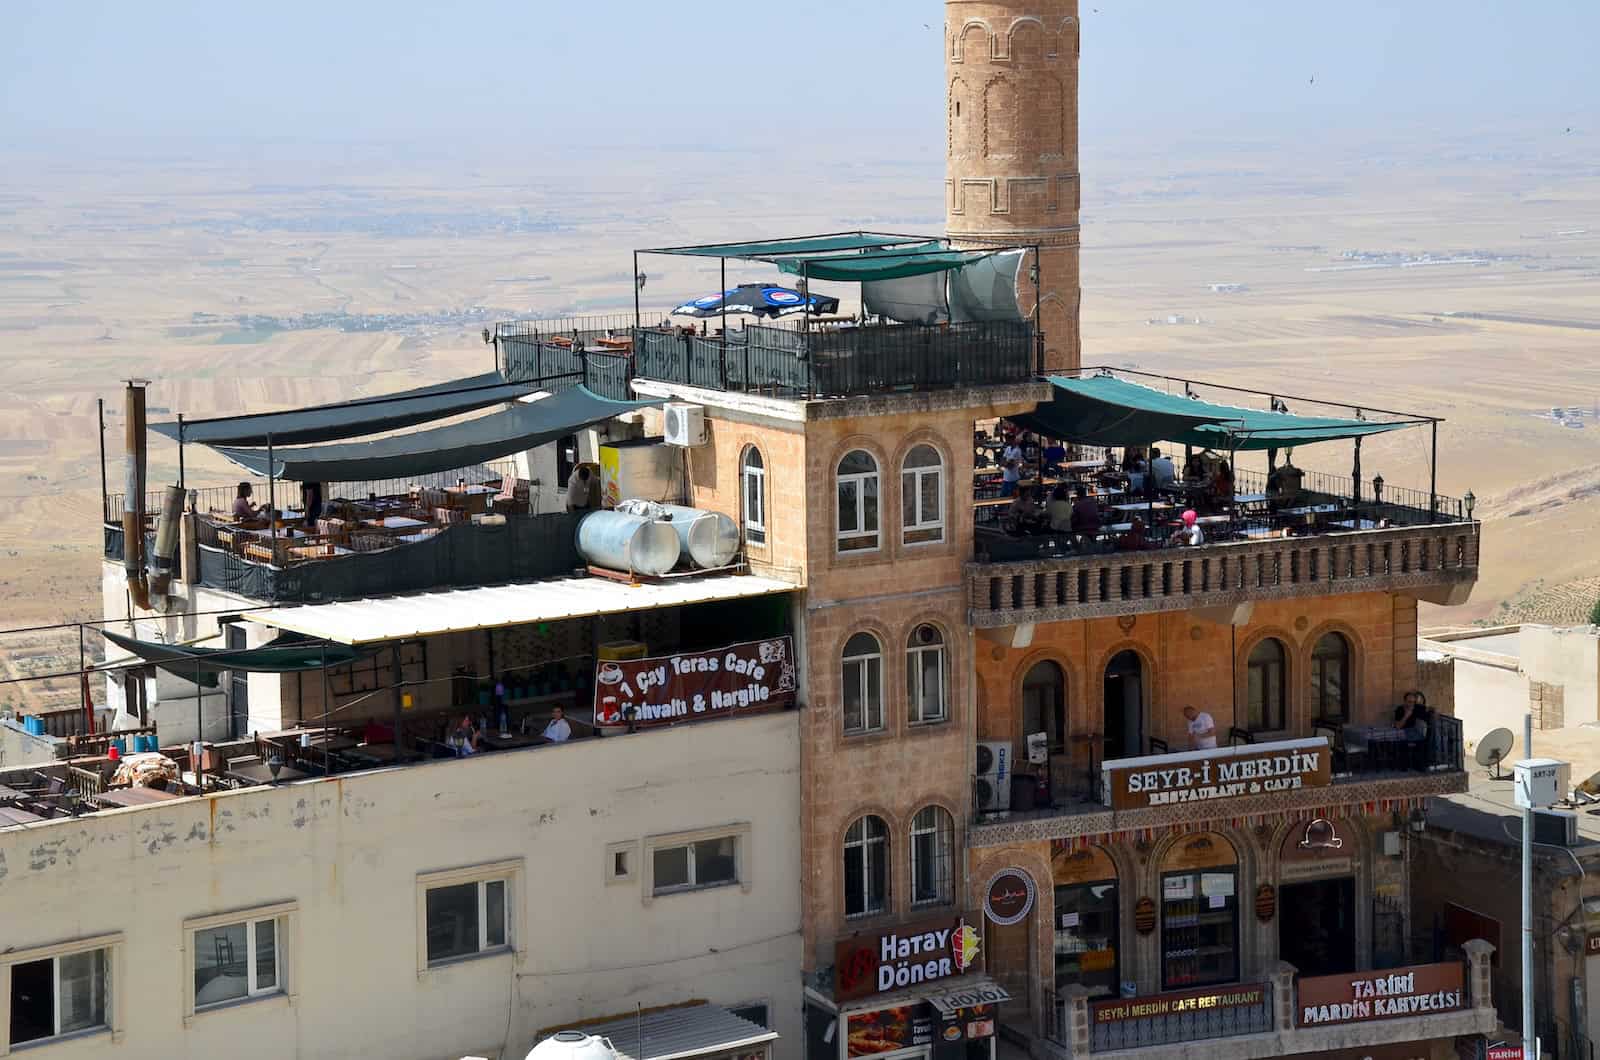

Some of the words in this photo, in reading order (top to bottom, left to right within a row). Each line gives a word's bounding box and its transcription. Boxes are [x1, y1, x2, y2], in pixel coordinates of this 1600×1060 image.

[620, 681, 635, 698] 1
[636, 666, 666, 694] Çay
[670, 655, 720, 676] Teras
[724, 652, 766, 680] Cafe
[692, 693, 706, 713] &
[711, 683, 770, 710] Nargile
[1128, 760, 1212, 793] SEYR-İ
[1218, 750, 1320, 782] MERDİN
[1149, 782, 1247, 805] RESTAURANT
[1249, 781, 1261, 793] &
[1264, 775, 1302, 791] CAFE
[1351, 972, 1415, 999] TARİHİ
[1131, 997, 1169, 1017] MERDİN
[1171, 994, 1197, 1011] CAFE
[1198, 989, 1261, 1010] RESTAURANT
[1303, 998, 1371, 1023] MARDİN
[1374, 988, 1461, 1016] KAHVECİSİ
